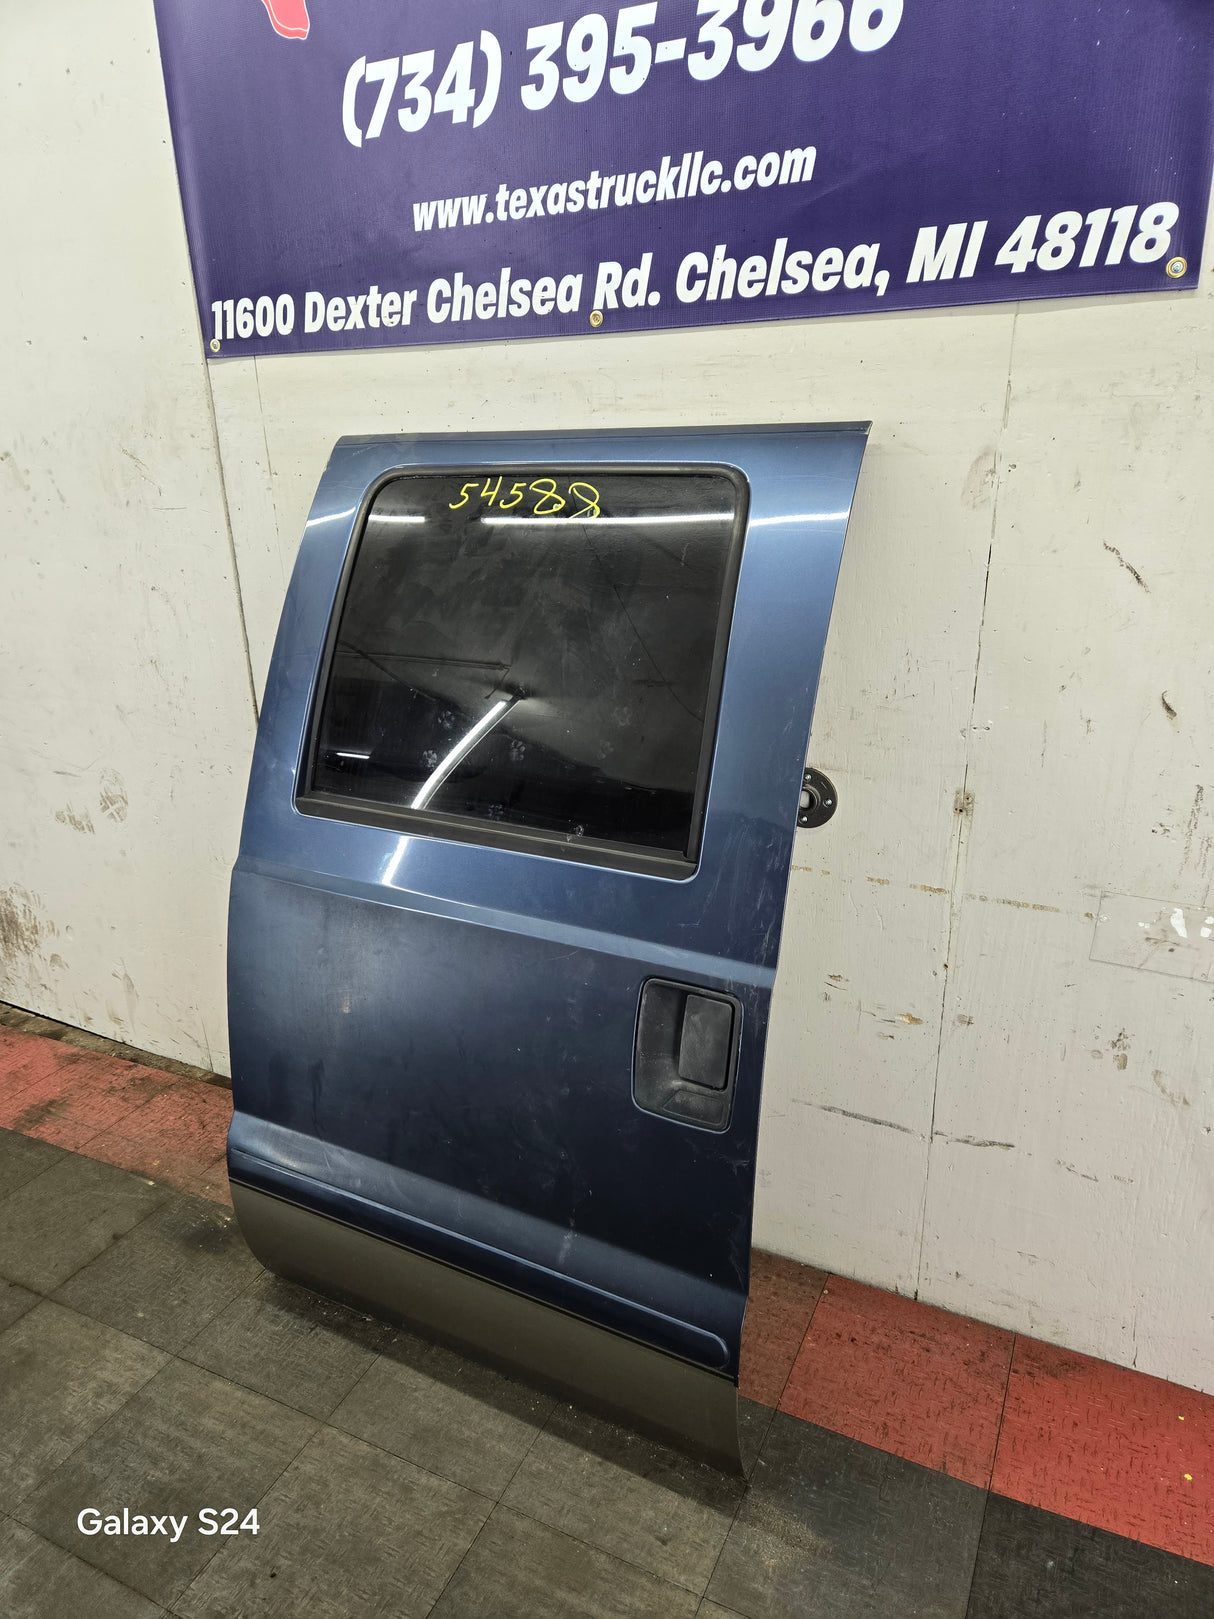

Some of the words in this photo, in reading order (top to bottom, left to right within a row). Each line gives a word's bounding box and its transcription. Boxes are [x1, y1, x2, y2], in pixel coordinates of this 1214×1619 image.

[342, 30, 501, 147] (734)
[413, 146, 817, 231] www.texastruckllc.com
[212, 294, 295, 340] 11600
[304, 285, 417, 333] Dexter
[427, 267, 583, 323] Chelsea
[592, 252, 660, 309] Rd.
[675, 237, 891, 304] Chelsea,
[905, 219, 989, 283] MI
[995, 201, 1180, 274] 48118
[449, 476, 600, 523] 54588
